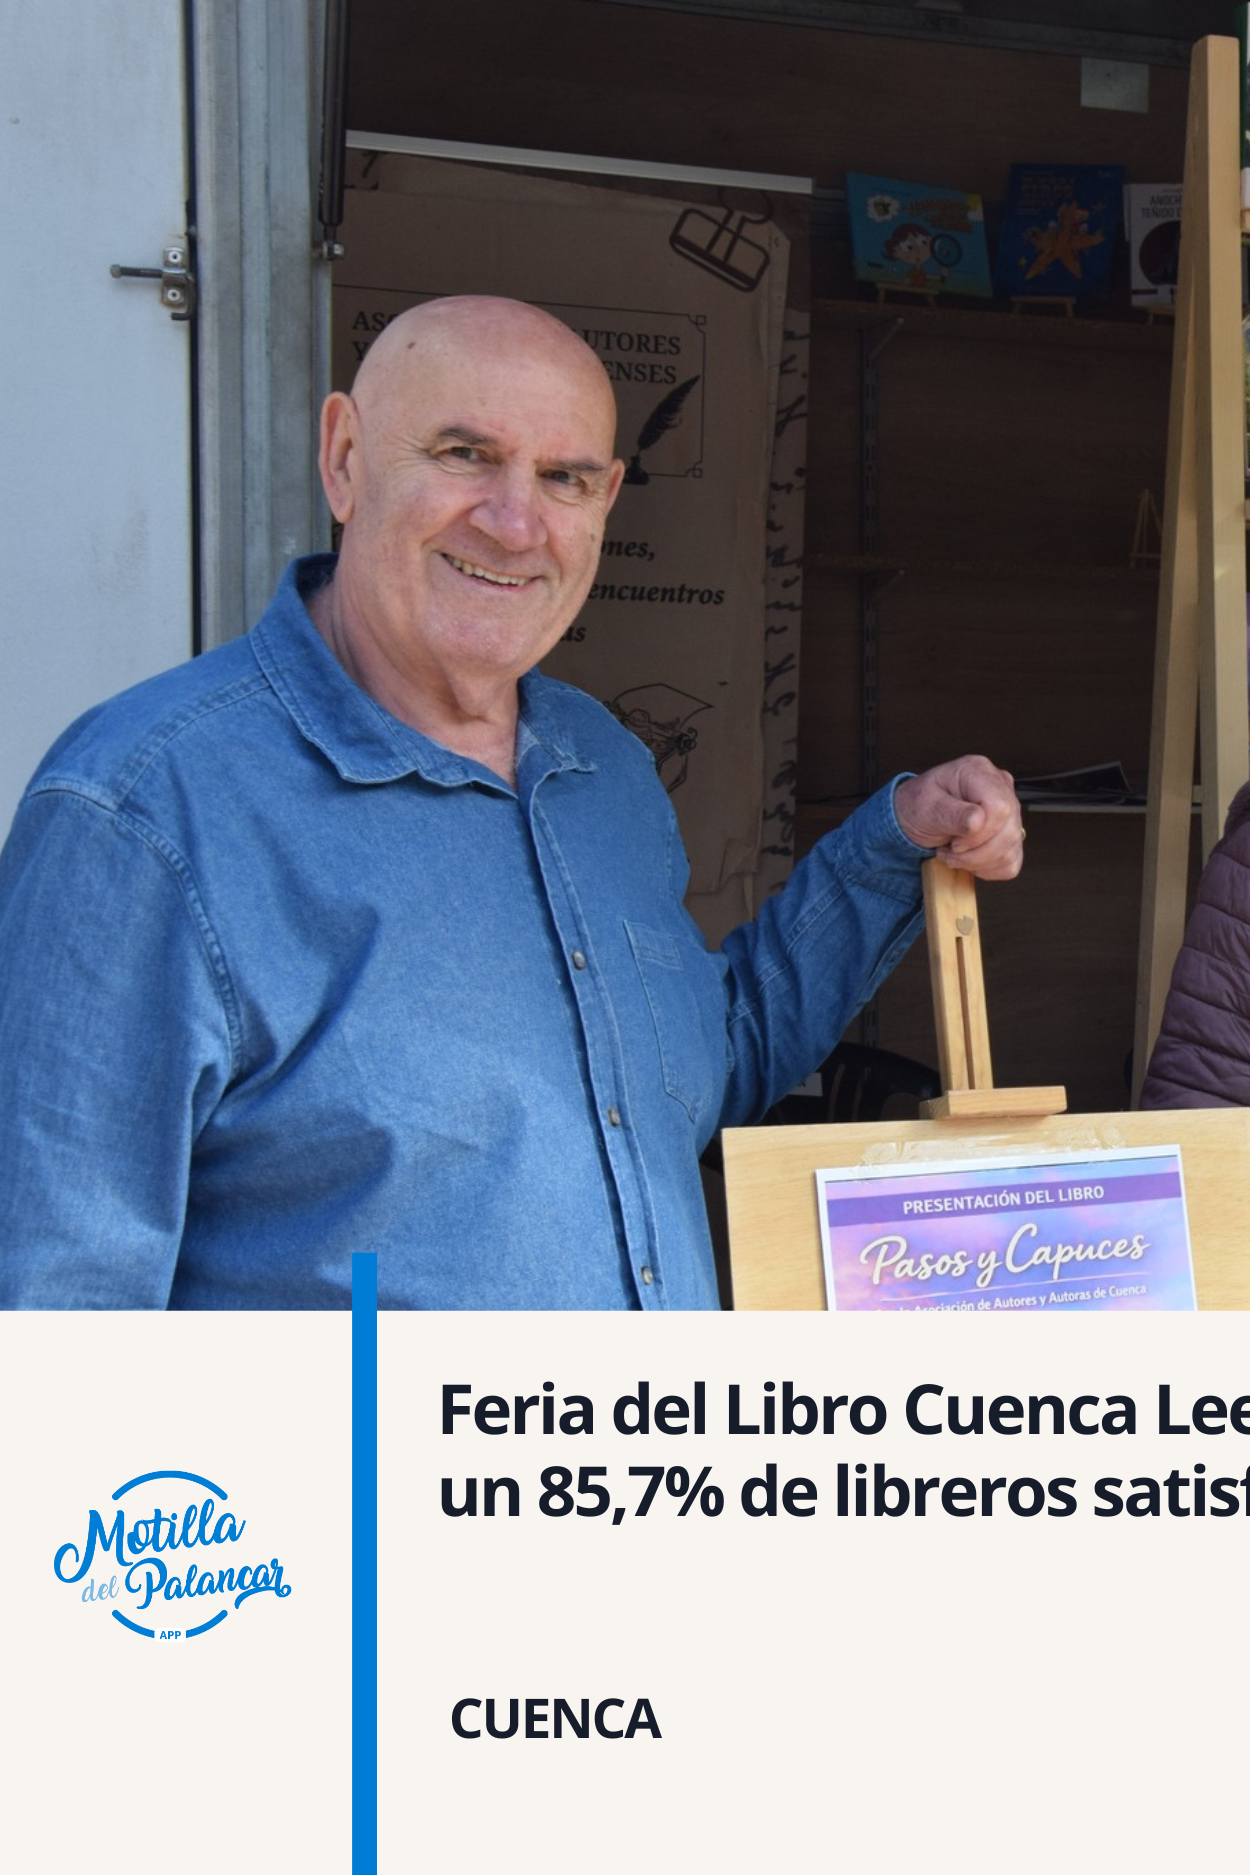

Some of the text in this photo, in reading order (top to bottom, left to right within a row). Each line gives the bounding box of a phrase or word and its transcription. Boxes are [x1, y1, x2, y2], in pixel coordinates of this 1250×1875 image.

[903, 1185, 1105, 1216] PRESENTACIÓN DEL LIBRO
[859, 1223, 1151, 1289] Pasos y Capuces
[978, 1298, 991, 1310] de
[994, 1296, 1037, 1309] Autores
[1039, 1296, 1047, 1306] y
[1048, 1291, 1091, 1304] Autoras
[1094, 1289, 1106, 1299] de
[1109, 1285, 1147, 1298] Cuenca
